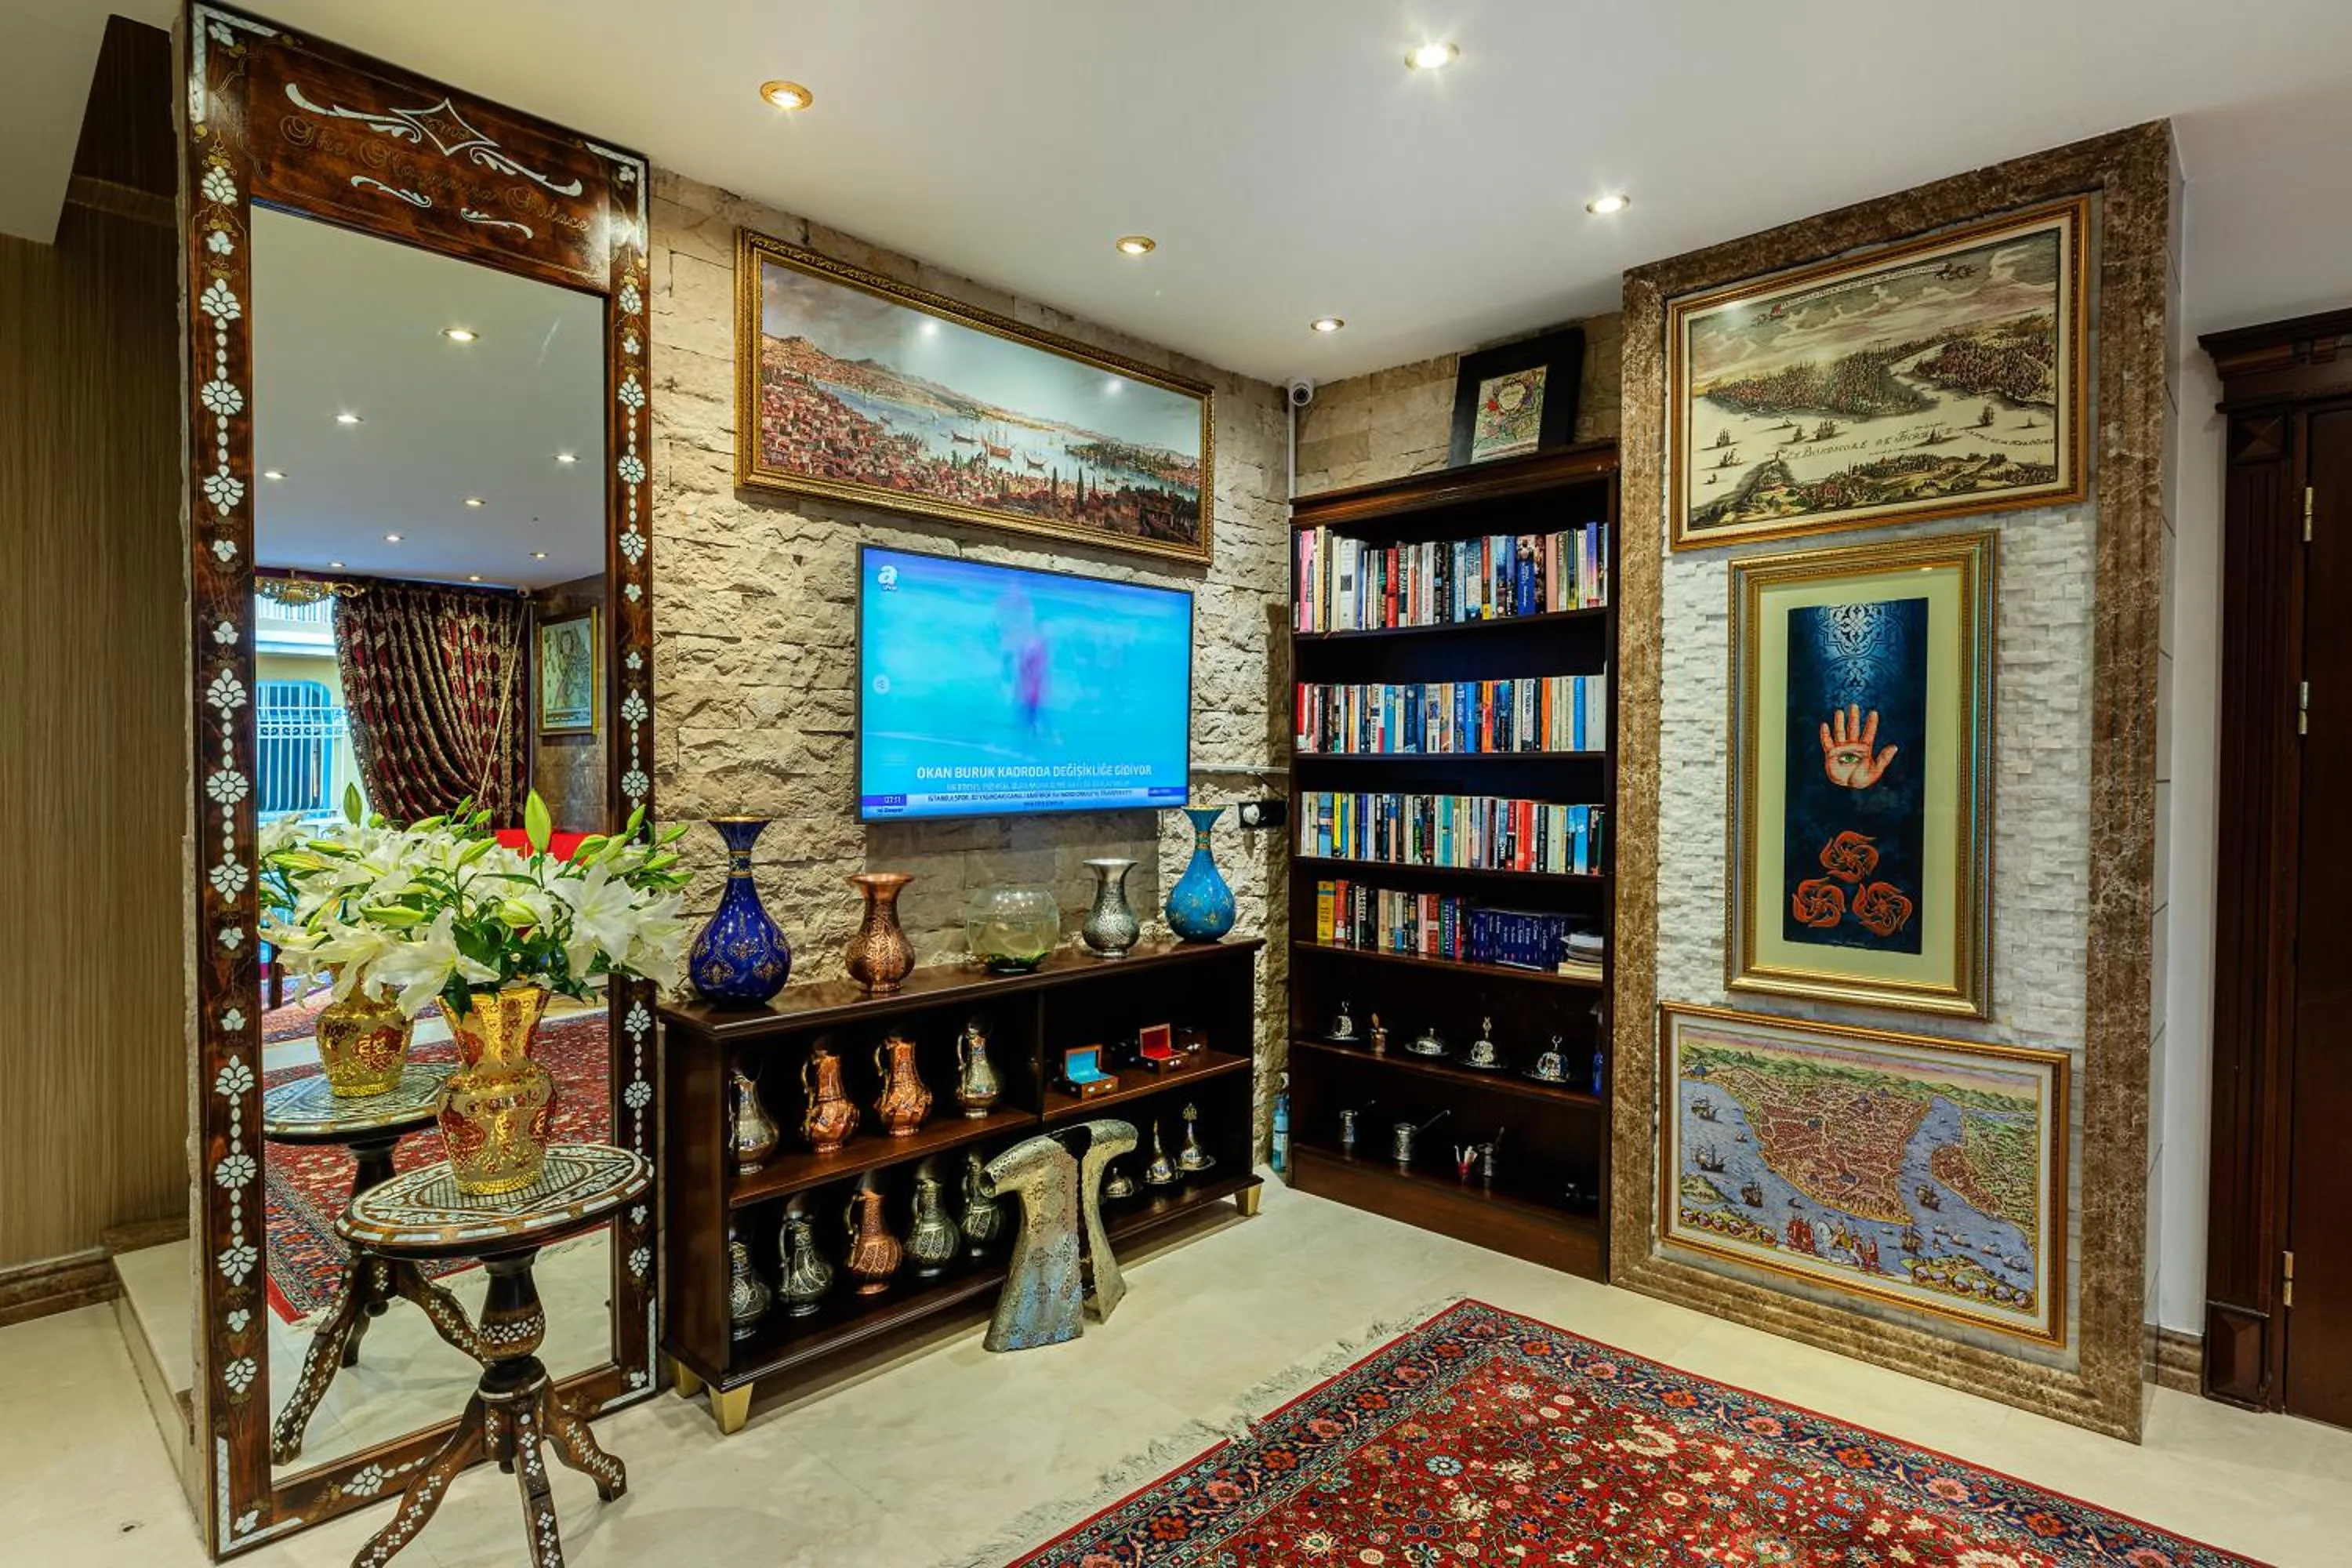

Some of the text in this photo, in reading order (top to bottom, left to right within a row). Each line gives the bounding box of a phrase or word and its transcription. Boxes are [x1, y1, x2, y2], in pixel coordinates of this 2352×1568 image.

[916, 766, 952, 779] OKAN
[954, 765, 995, 779] BURUK
[998, 765, 1050, 778] KADRODA
